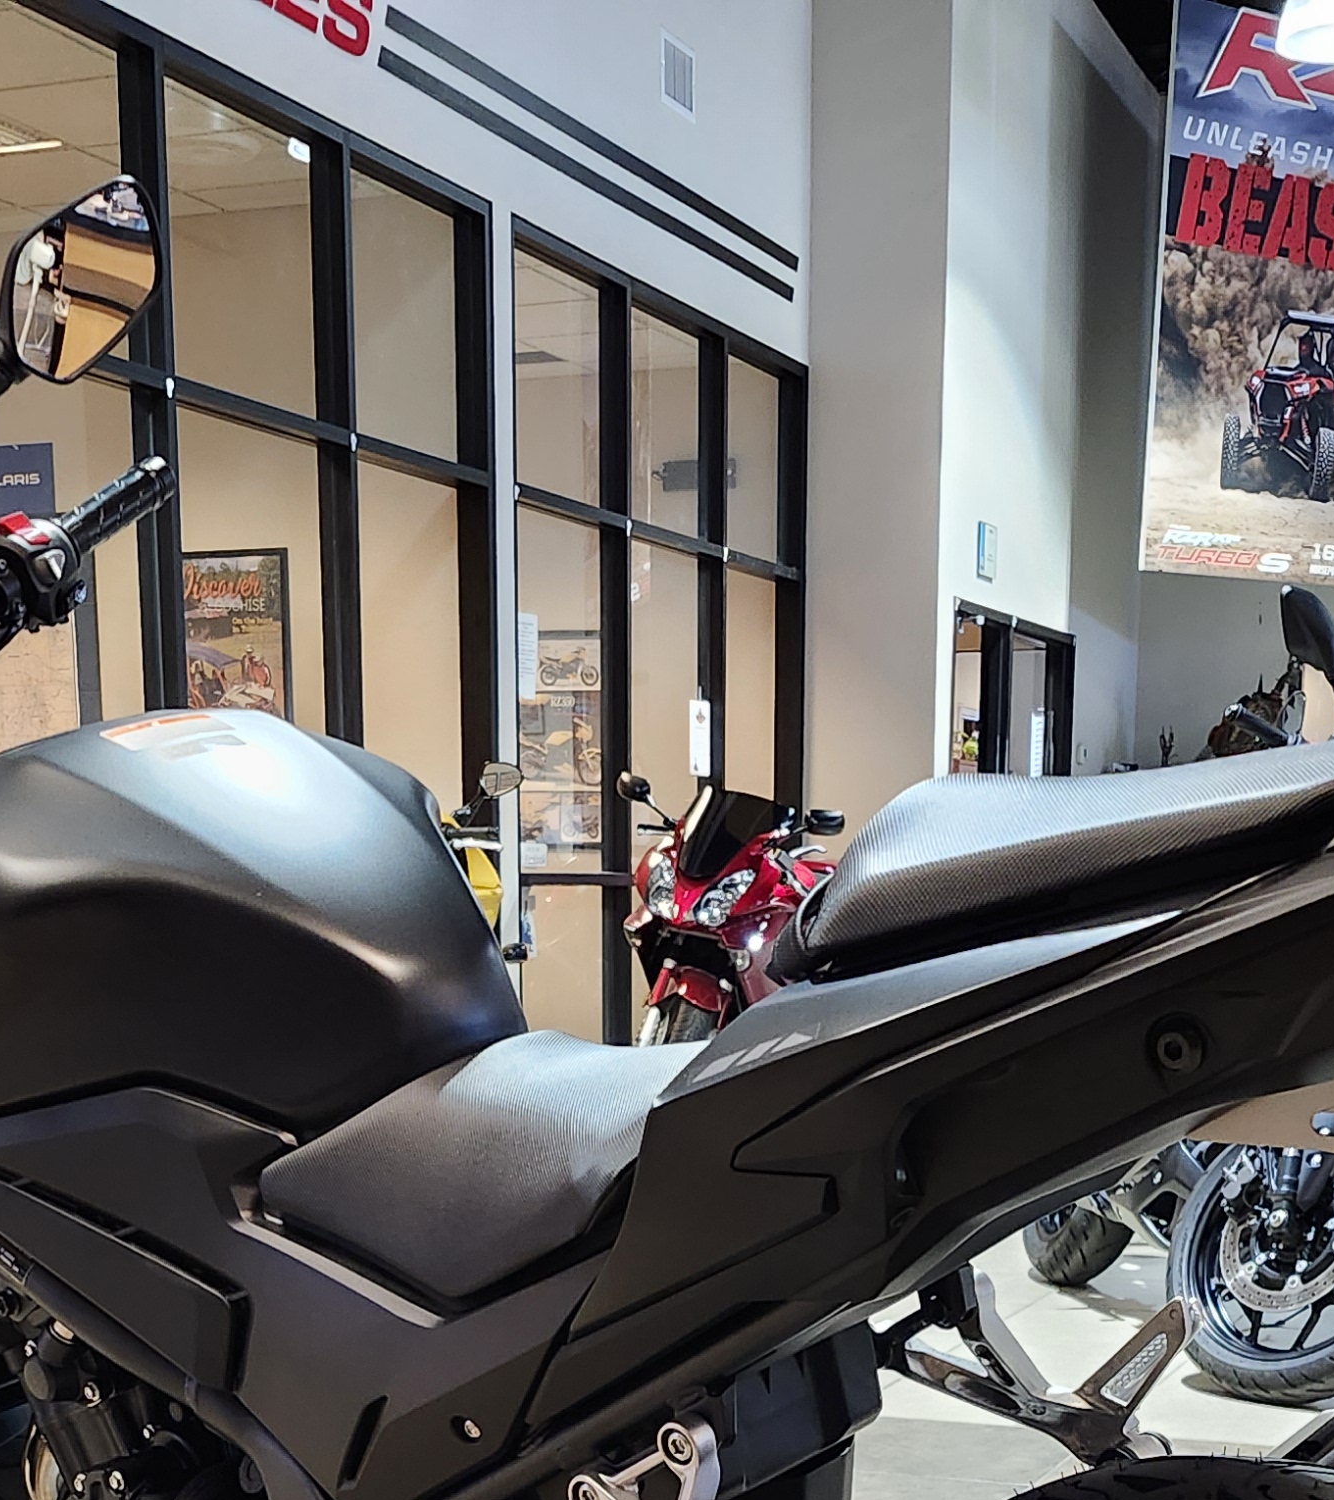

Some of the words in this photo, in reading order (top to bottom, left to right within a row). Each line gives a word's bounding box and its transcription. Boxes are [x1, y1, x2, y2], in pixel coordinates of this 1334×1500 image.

[1182, 115, 1334, 170] UNLEASH
[1157, 545, 1260, 568] TURBO
[1256, 552, 1293, 574] S
